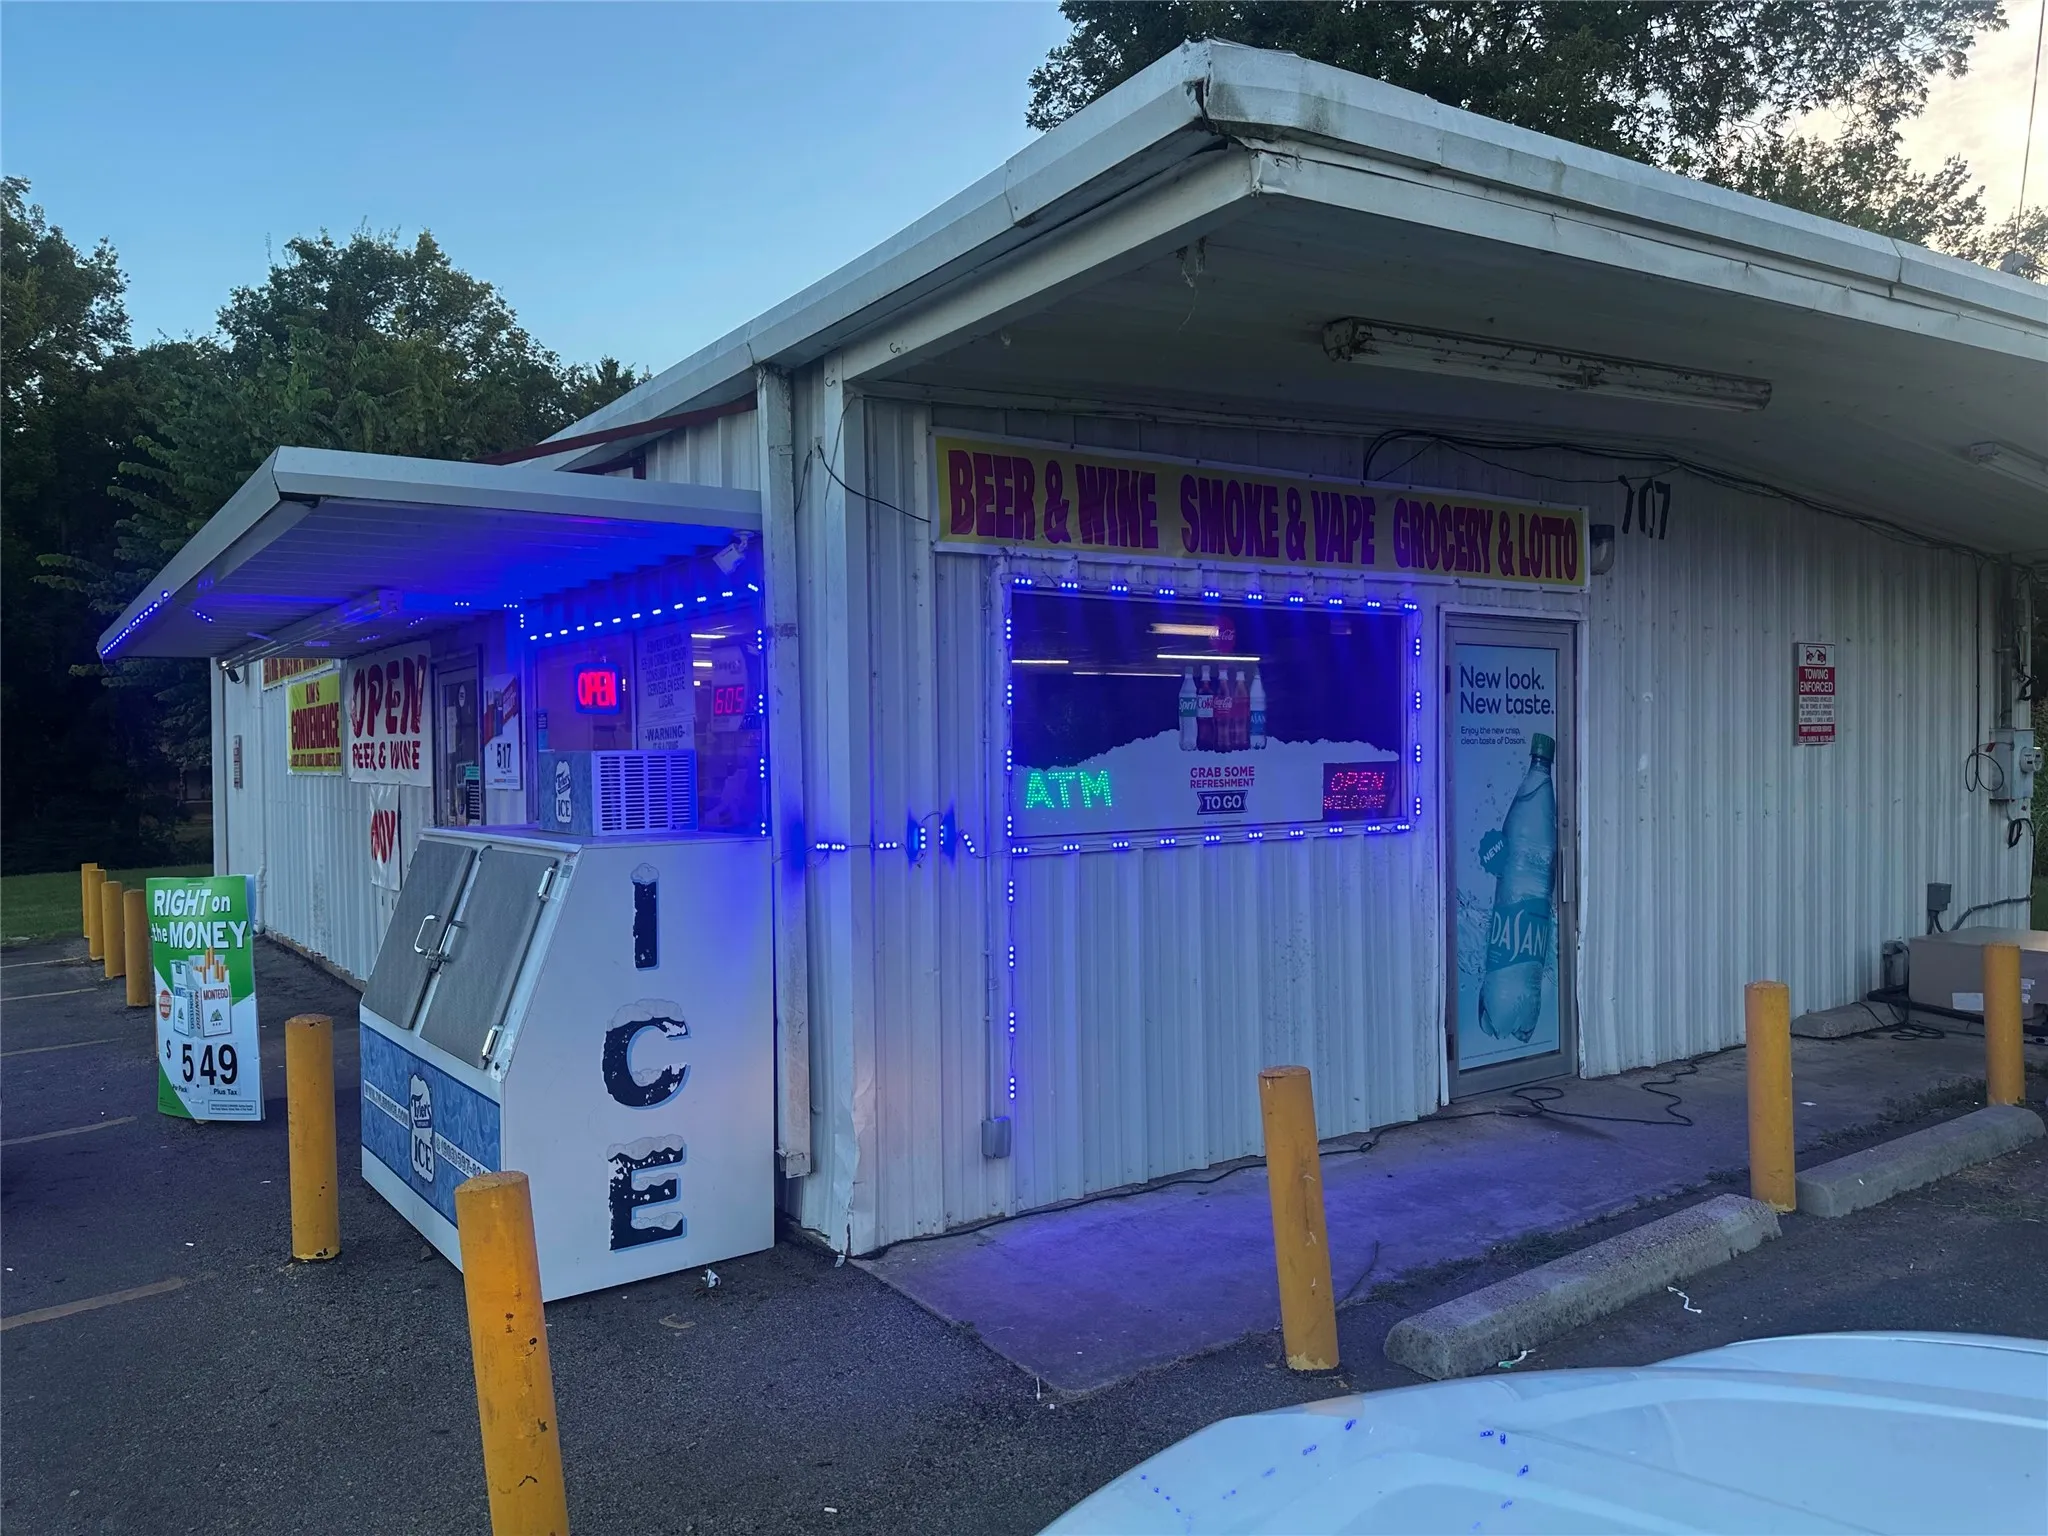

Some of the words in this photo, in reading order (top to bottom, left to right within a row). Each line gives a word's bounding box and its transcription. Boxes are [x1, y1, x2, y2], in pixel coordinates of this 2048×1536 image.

[948, 450, 1035, 541] BEER
[1043, 460, 1071, 544] &
[1075, 464, 1158, 549] WINE
[1180, 474, 1279, 558] SMOKE
[1286, 487, 1306, 561] &
[1311, 490, 1376, 565] VAPE
[1393, 498, 1493, 573] GROCERY
[1498, 511, 1514, 576] &
[1519, 512, 1577, 581] LOTTO
[1618, 475, 1671, 540] 707
[1461, 666, 1501, 689] New
[1506, 666, 1544, 690] look.
[1804, 669, 1828, 680] TOWING
[350, 654, 428, 738] OPEN
[578, 671, 616, 706] OPEN
[1800, 682, 1833, 692] ENFORCED
[1461, 692, 1501, 714] New
[1506, 693, 1554, 715] taste.
[291, 703, 340, 750] CONVENIENCE
[1461, 726, 1479, 736] Enjoy
[1480, 727, 1491, 735] the
[1461, 737, 1478, 745] clean
[1479, 737, 1495, 745] taste
[1496, 737, 1504, 745] of
[352, 741, 376, 771] BEER
[378, 741, 386, 770] &
[390, 740, 421, 770] WINE
[1190, 767, 1221, 779] GRAB
[1224, 766, 1255, 777] SOME
[1190, 777, 1255, 789] REFRESHMENT
[1331, 772, 1385, 791] OPEN
[1025, 770, 1112, 808] ATM
[558, 799, 571, 817] ICE
[1204, 796, 1222, 810] TO
[1223, 796, 1242, 809] GO
[1324, 794, 1386, 809] WELCOME
[1483, 839, 1504, 863] NEW!
[154, 889, 212, 916] RIGHT
[211, 895, 231, 912] on
[151, 922, 168, 943] the
[169, 920, 247, 949] MONEY
[1491, 909, 1547, 962] DASANI
[204, 989, 228, 1000] MONTEGO
[166, 1040, 171, 1059] $
[601, 863, 691, 1251] ICE
[227, 1088, 238, 1096] Tax
[411, 1094, 431, 1118] Tyler's
[413, 1134, 432, 1174] ICE
